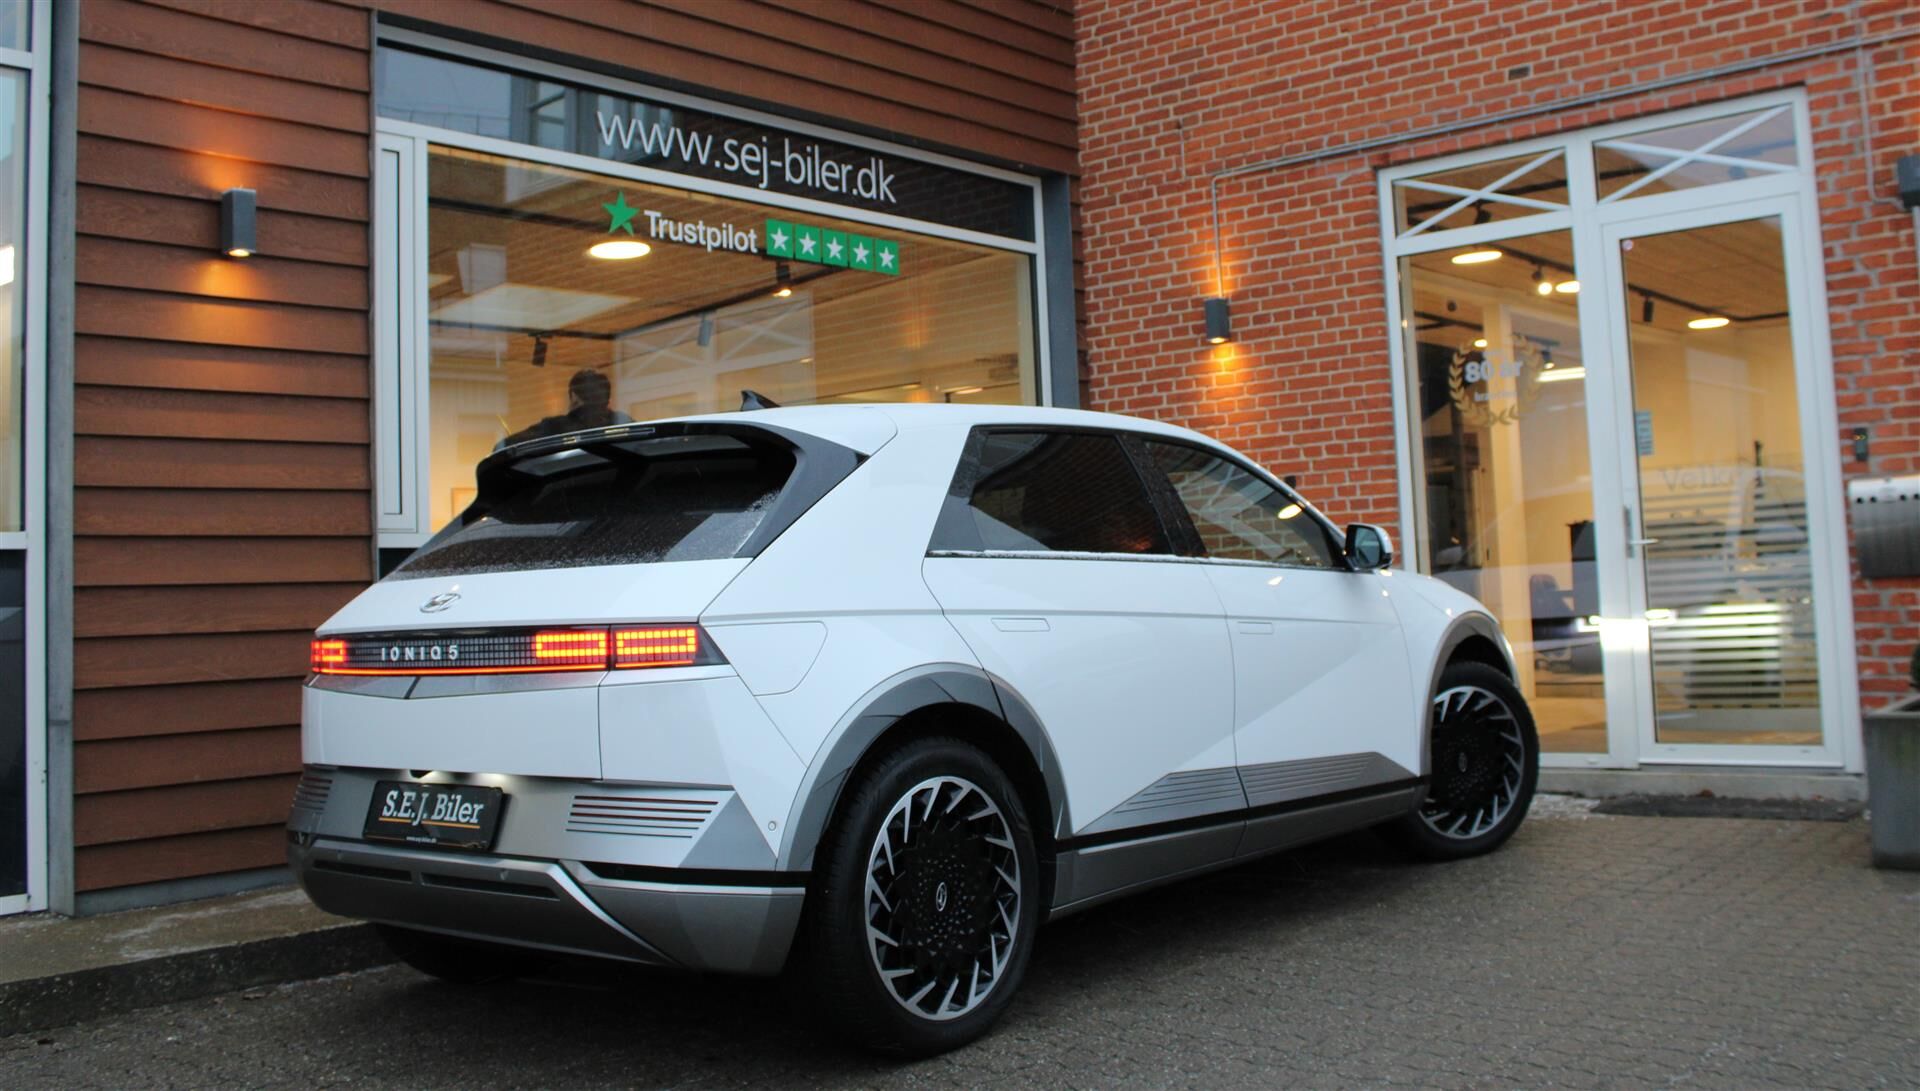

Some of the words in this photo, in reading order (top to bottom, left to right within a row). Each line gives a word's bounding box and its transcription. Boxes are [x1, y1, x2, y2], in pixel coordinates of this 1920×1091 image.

[597, 111, 897, 203] www.sej-biler.dk
[644, 209, 758, 254] Trustpilot
[381, 646, 441, 661] IONIQ
[448, 645, 459, 660] 5
[382, 789, 428, 827] S.E.J.
[431, 793, 484, 824] Biler
